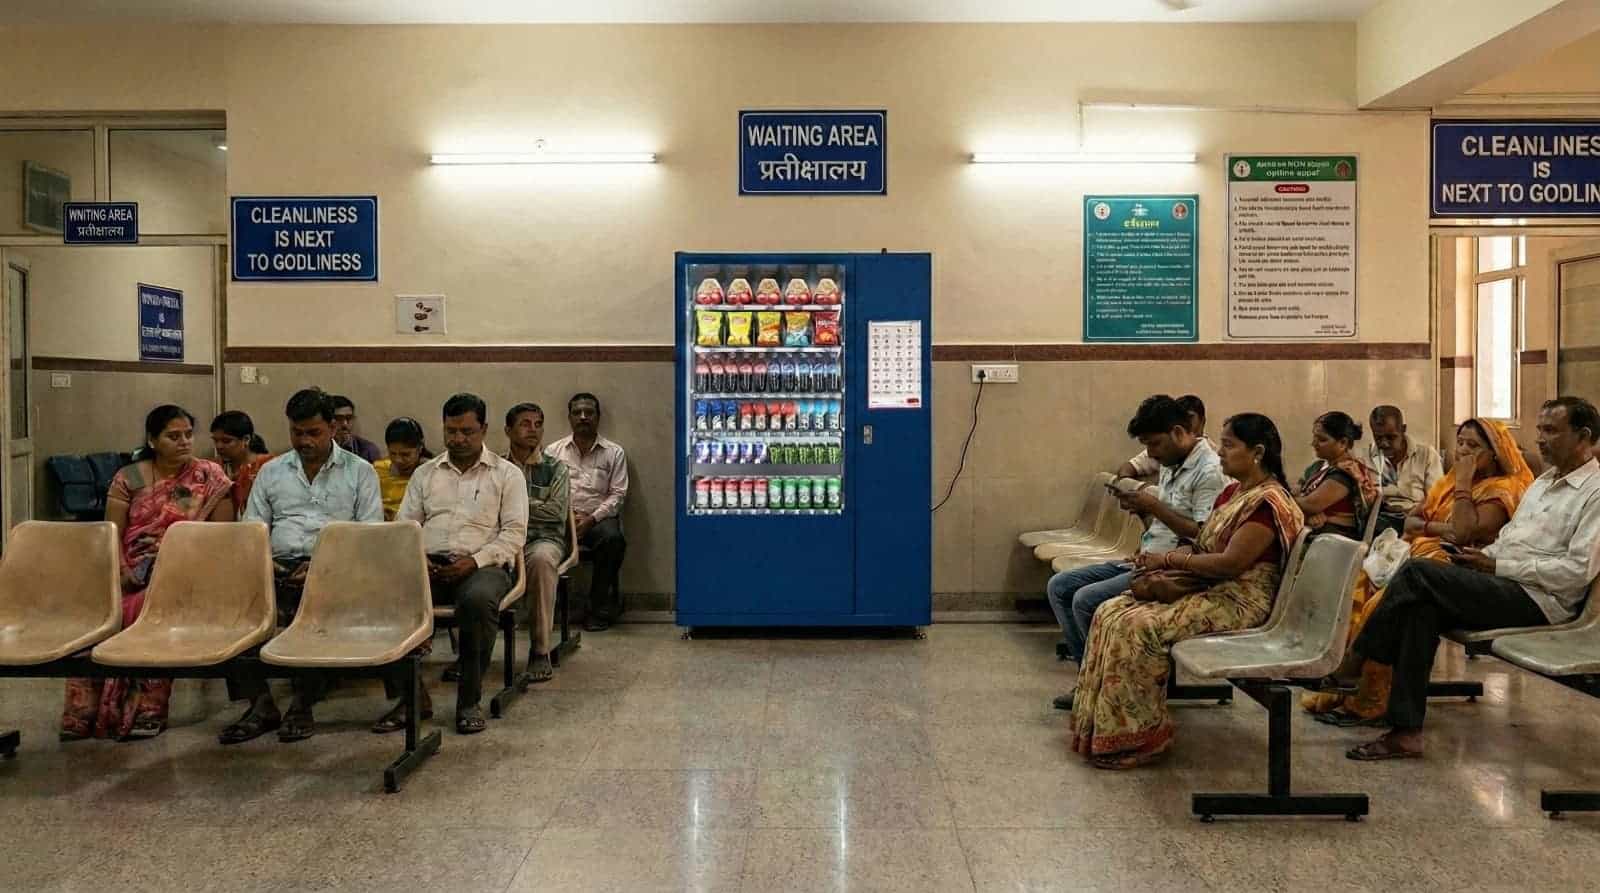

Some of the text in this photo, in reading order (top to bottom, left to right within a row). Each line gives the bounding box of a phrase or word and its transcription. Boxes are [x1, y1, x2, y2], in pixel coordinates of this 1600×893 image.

[748, 125, 879, 147] WAITING AREA
[758, 153, 867, 181] प्रतीक्षालय
[1532, 161, 1551, 178] IS
[1442, 183, 1493, 203] NEXT
[1497, 183, 1524, 203] TO
[108, 208, 134, 221] AREA
[251, 206, 358, 224] CLEANLINESS
[275, 230, 335, 248] IS NEXT
[248, 253, 362, 271] TO GODLINESS
